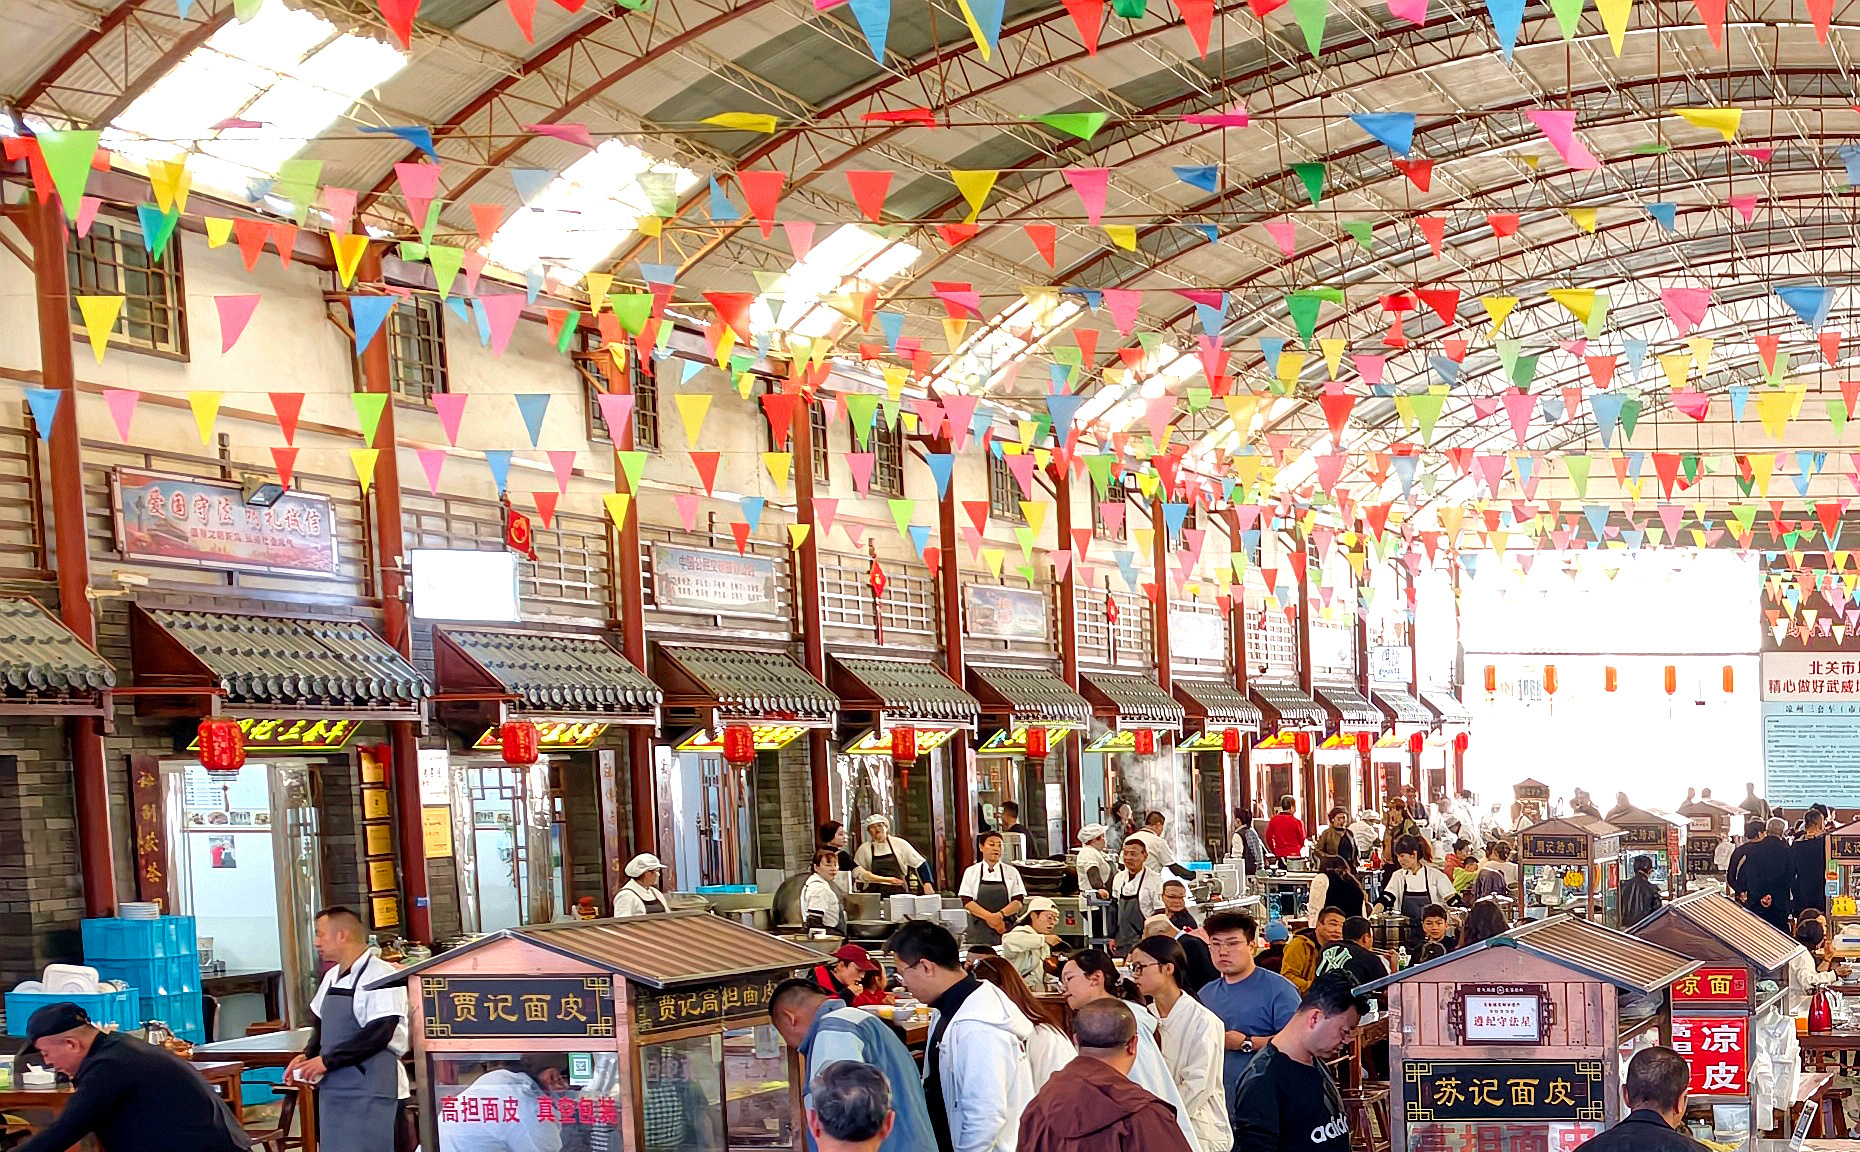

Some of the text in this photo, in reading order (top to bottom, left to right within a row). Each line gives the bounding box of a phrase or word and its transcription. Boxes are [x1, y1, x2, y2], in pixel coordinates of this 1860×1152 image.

[147, 486, 235, 524] 爱国守法
[1316, 945, 1353, 977] NY
[1676, 973, 1734, 995] 凉面
[449, 992, 588, 1023] 贾记面皮
[1701, 1024, 1741, 1090] 凉皮
[1433, 1075, 1576, 1107] 苏记面皮
[440, 1095, 618, 1126] 高担面皮 真空包装
